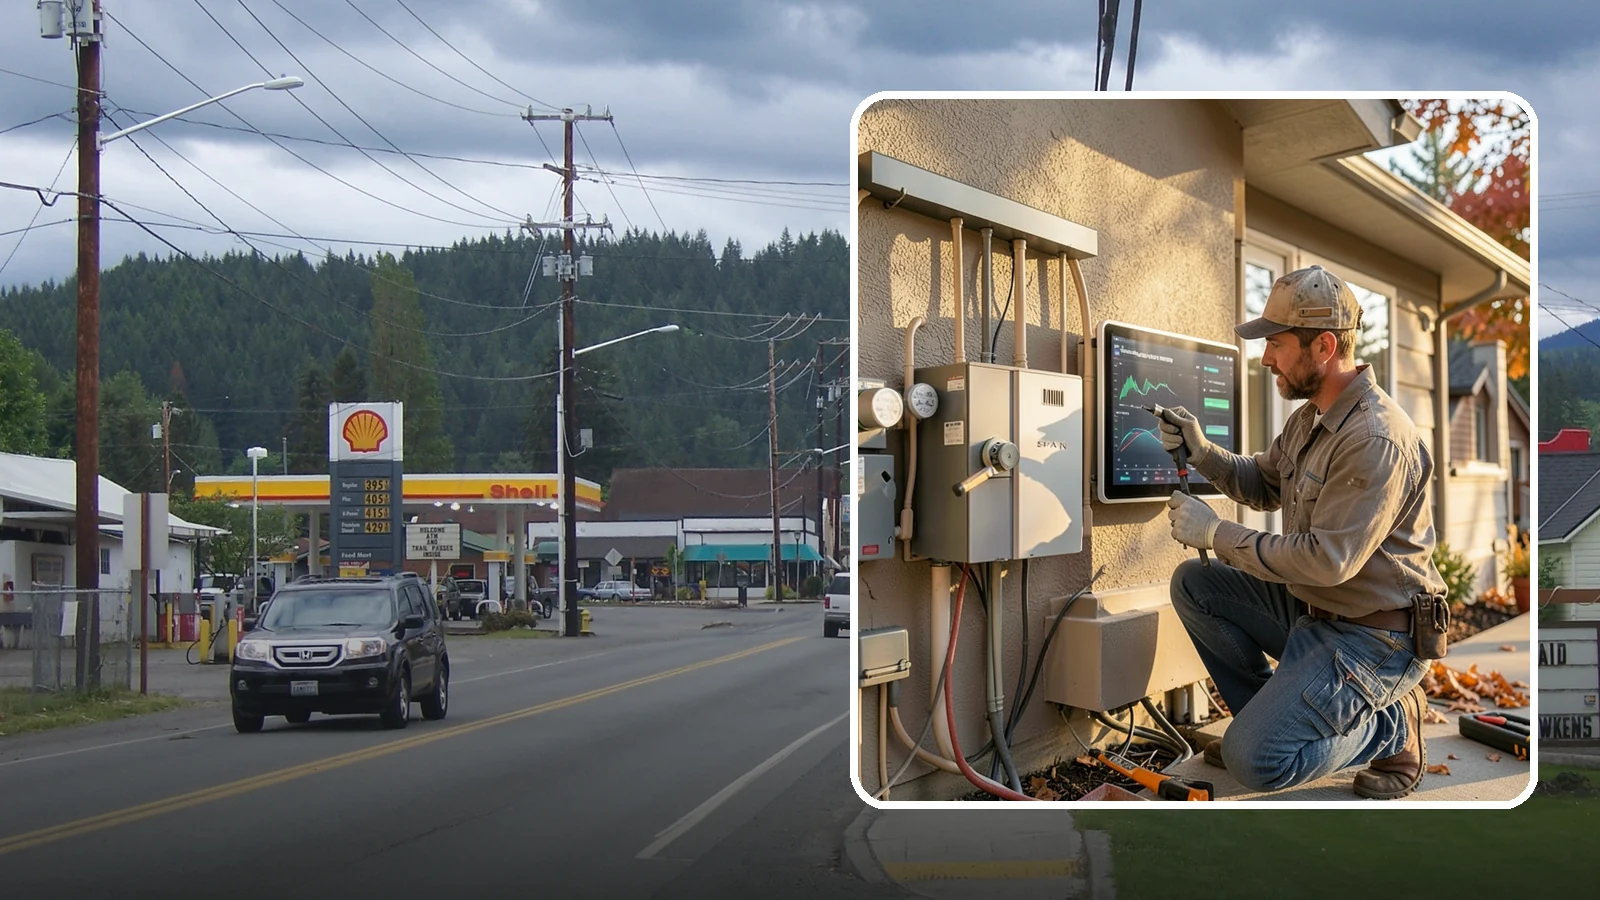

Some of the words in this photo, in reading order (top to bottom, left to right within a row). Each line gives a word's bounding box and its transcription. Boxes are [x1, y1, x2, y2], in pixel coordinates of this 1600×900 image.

[366, 480, 384, 490] 395
[490, 484, 547, 499] Shell
[365, 494, 384, 504] 405
[365, 508, 383, 518] 415
[365, 522, 384, 533] 429
[1538, 642, 1567, 666] AID
[1538, 715, 1592, 739] WKENS
